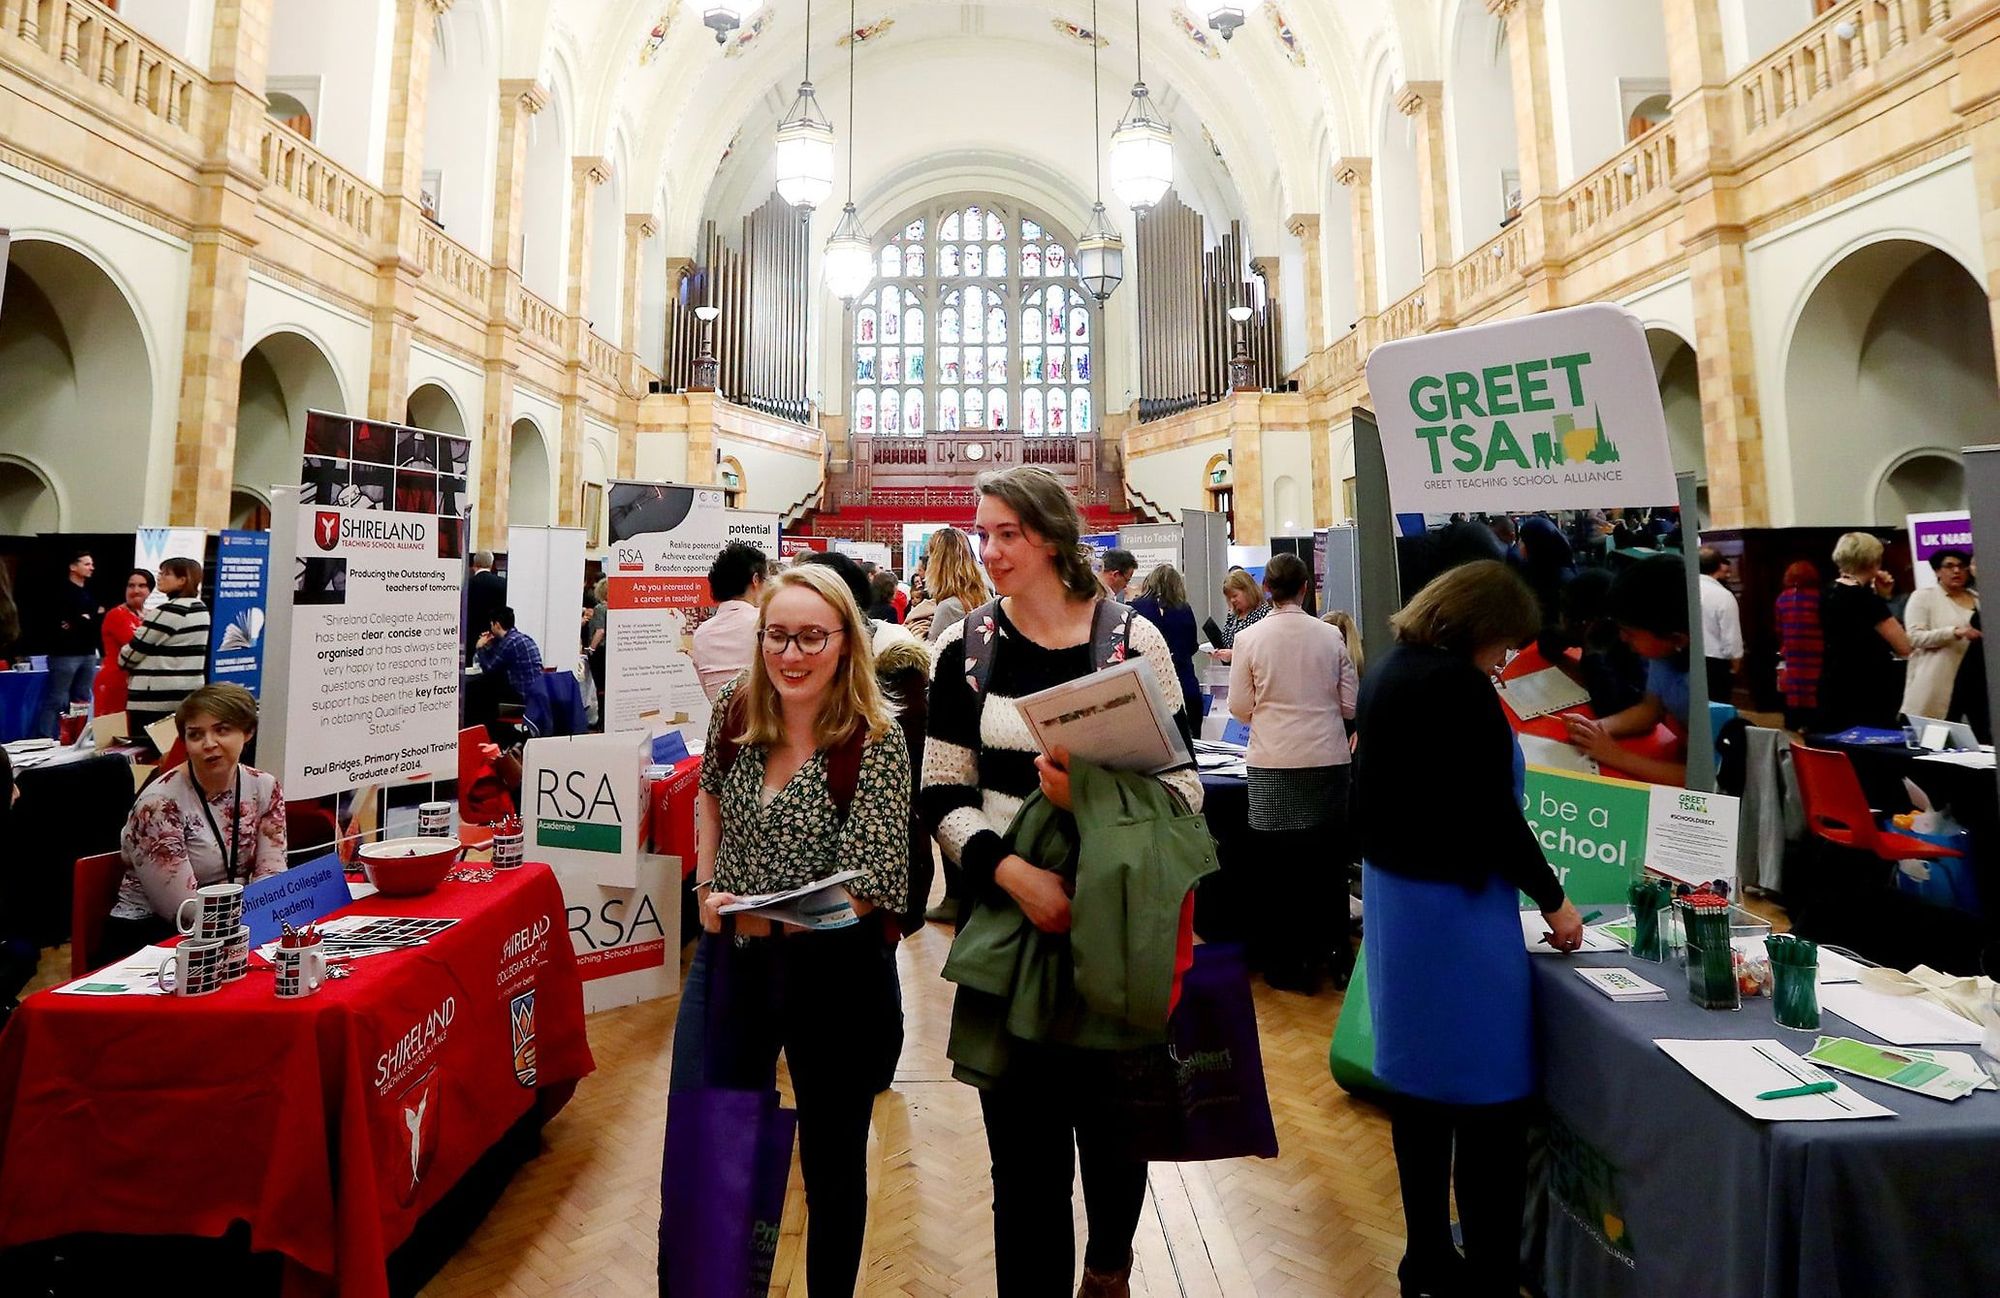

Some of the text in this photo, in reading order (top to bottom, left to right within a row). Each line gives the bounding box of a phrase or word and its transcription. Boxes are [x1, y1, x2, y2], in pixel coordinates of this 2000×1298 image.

[1409, 352, 1591, 421] GREET
[1415, 420, 1531, 474] TSA
[1424, 470, 1622, 490] GREET TEACHING SCHOOL ALLIANCE
[341, 518, 425, 541] SHIRELAND
[729, 524, 771, 535] potential
[342, 540, 425, 551] TEACHING SCHOOL ALLIANCE
[669, 540, 720, 550] Realise potential
[1122, 532, 1178, 544] Train to Teach
[1921, 534, 1941, 546] UK
[618, 549, 644, 563] RSA
[661, 552, 718, 561] Achieve excellenc
[350, 569, 446, 581] Producing the Outstanding
[654, 563, 682, 572] Broaden
[386, 584, 419, 592] teachers
[420, 584, 428, 592] of
[632, 582, 702, 594] Are you interested in
[640, 595, 663, 603] career
[664, 595, 671, 603] in
[369, 613, 414, 627] Collegiate
[416, 612, 456, 623] Academy
[315, 632, 335, 643] has
[337, 631, 359, 642] been
[388, 627, 422, 639] concise
[424, 627, 441, 637] and
[317, 646, 364, 662] organised
[366, 646, 383, 656] and
[385, 644, 402, 655] has
[404, 642, 435, 653] always
[323, 665, 344, 676] very
[346, 662, 373, 675] happy
[376, 661, 386, 671] to
[388, 657, 427, 670] respond
[429, 657, 439, 667] to
[321, 679, 366, 694] questions
[367, 676, 386, 687] and
[433, 670, 454, 680] Their
[312, 685, 458, 711] support has been the key factor
[320, 700, 453, 727] in obtaining Qualified Teacher
[303, 741, 458, 777] Paul Bridges, Primary School Trainee
[349, 766, 388, 782] Graduate
[390, 763, 399, 774] of
[537, 769, 622, 823] RSA
[1679, 794, 1707, 805] GREET
[1540, 790, 1578, 822] be
[1588, 807, 1609, 829] a
[1678, 801, 1696, 812] TSA
[537, 821, 576, 833] Academies
[1670, 814, 1715, 826] #SCHOOLDIRECT
[241, 869, 332, 915] Shireland Collegiate
[272, 895, 314, 922] Academy
[567, 894, 664, 949] RSA
[603, 947, 632, 960] School
[633, 943, 664, 954] Alliance
[375, 996, 455, 1087] SHIRELAND
